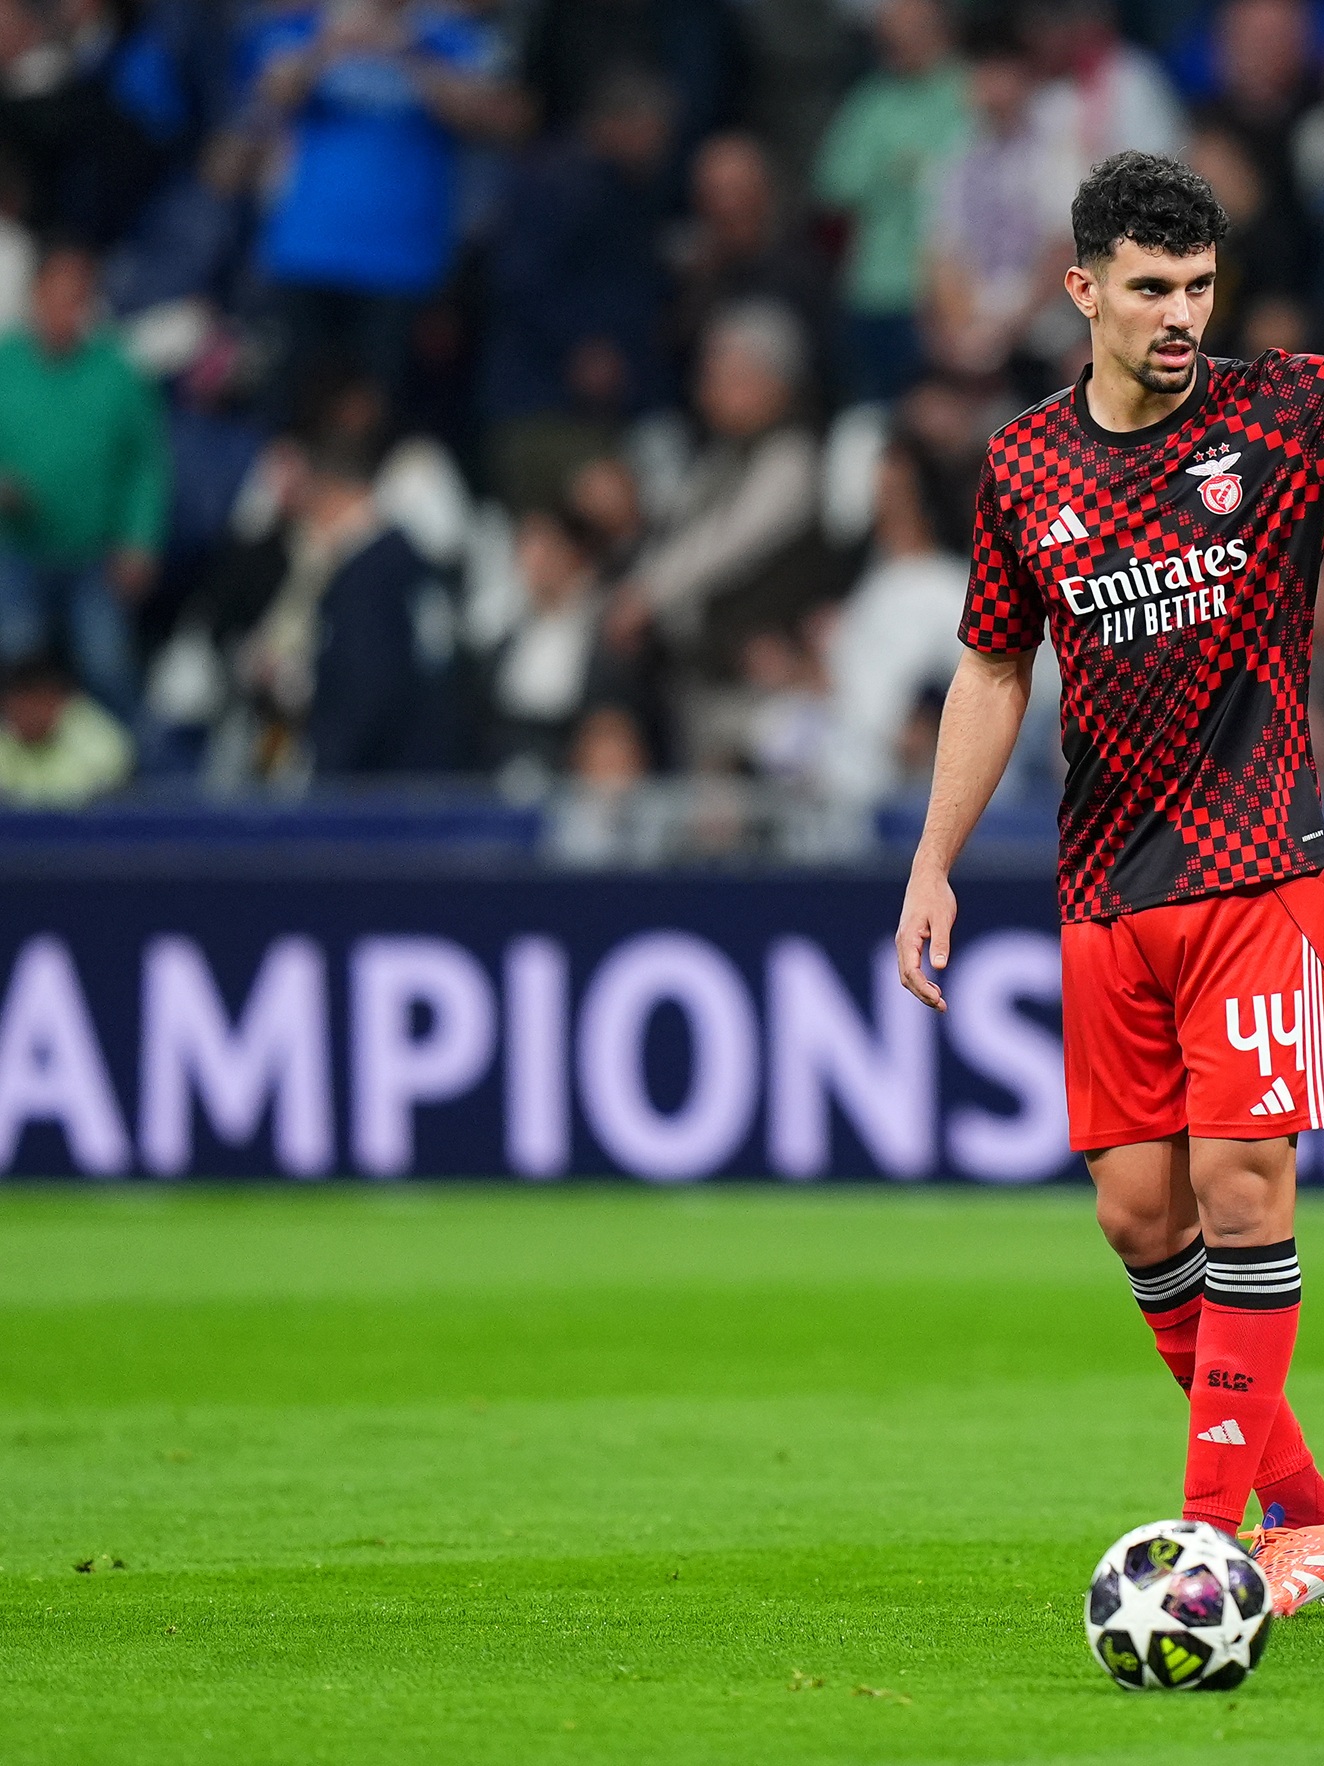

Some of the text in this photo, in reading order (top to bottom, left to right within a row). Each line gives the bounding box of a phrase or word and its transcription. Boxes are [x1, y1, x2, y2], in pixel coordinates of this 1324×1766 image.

[1058, 538, 1248, 616] Emirates
[1103, 584, 1228, 646] FLY BETTER
[1226, 990, 1306, 1077] 44
